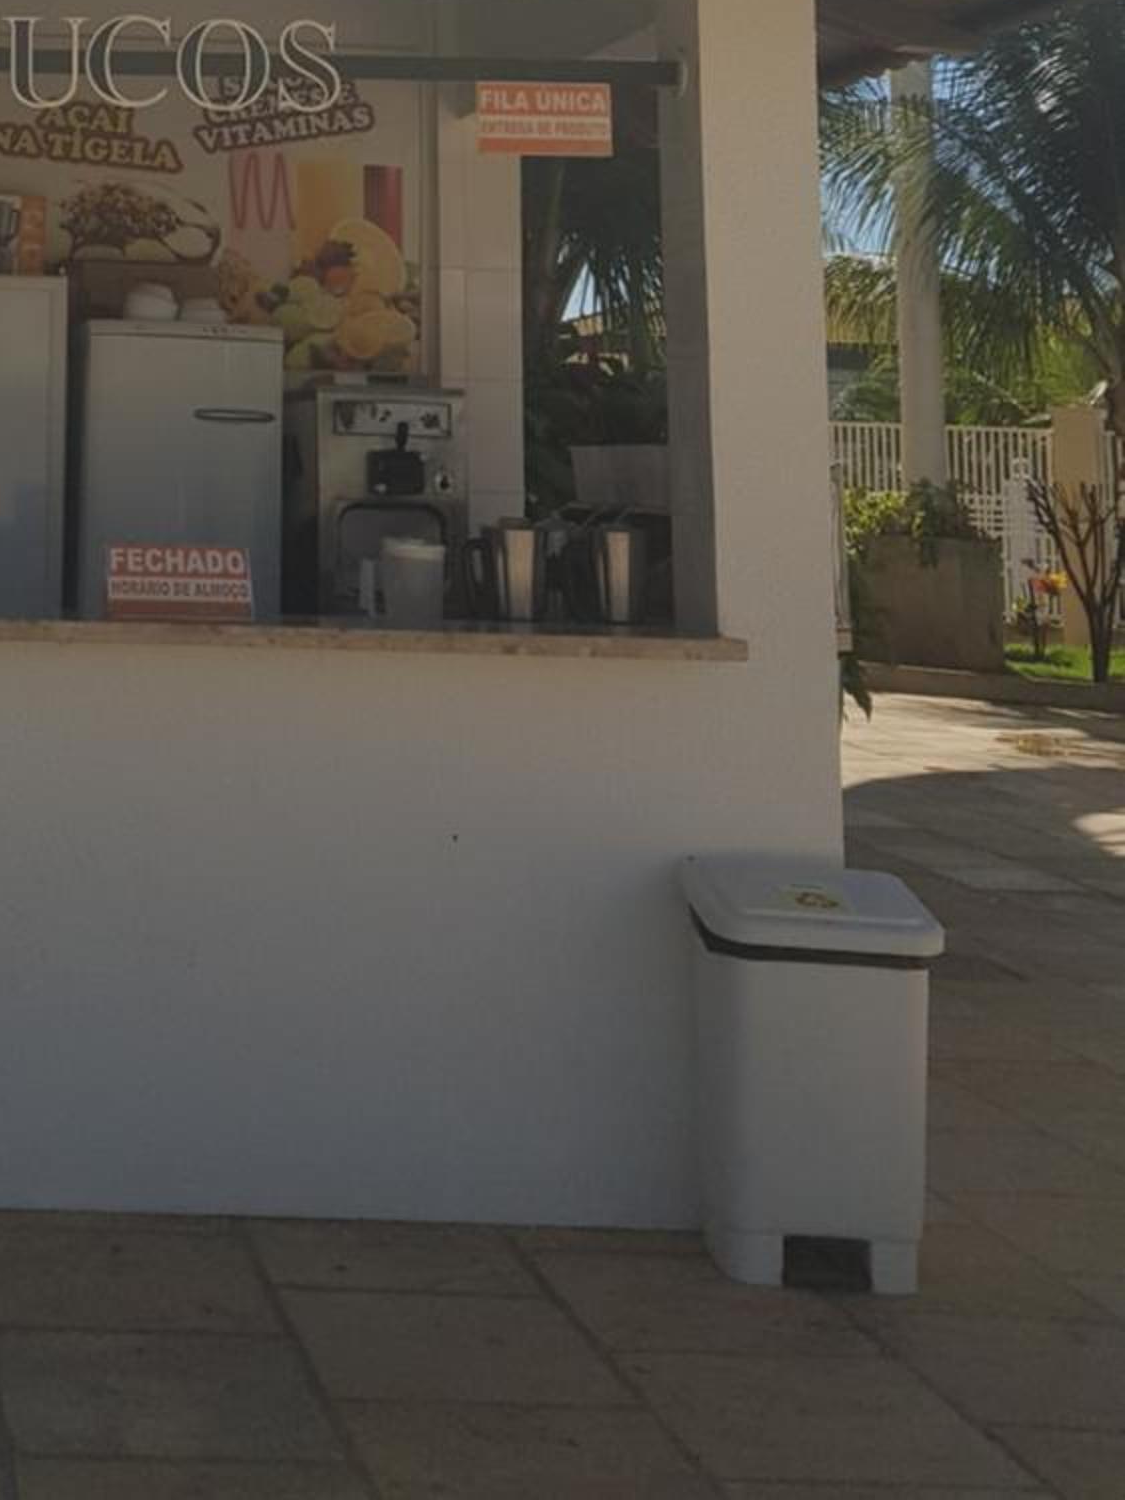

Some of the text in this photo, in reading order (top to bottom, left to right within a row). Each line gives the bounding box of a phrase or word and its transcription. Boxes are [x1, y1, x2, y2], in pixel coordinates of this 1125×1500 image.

[480, 90, 531, 112] FILA
[197, 106, 371, 152] VITAMINAS
[47, 130, 180, 171] TIGELA
[109, 548, 245, 574] FECHADO
